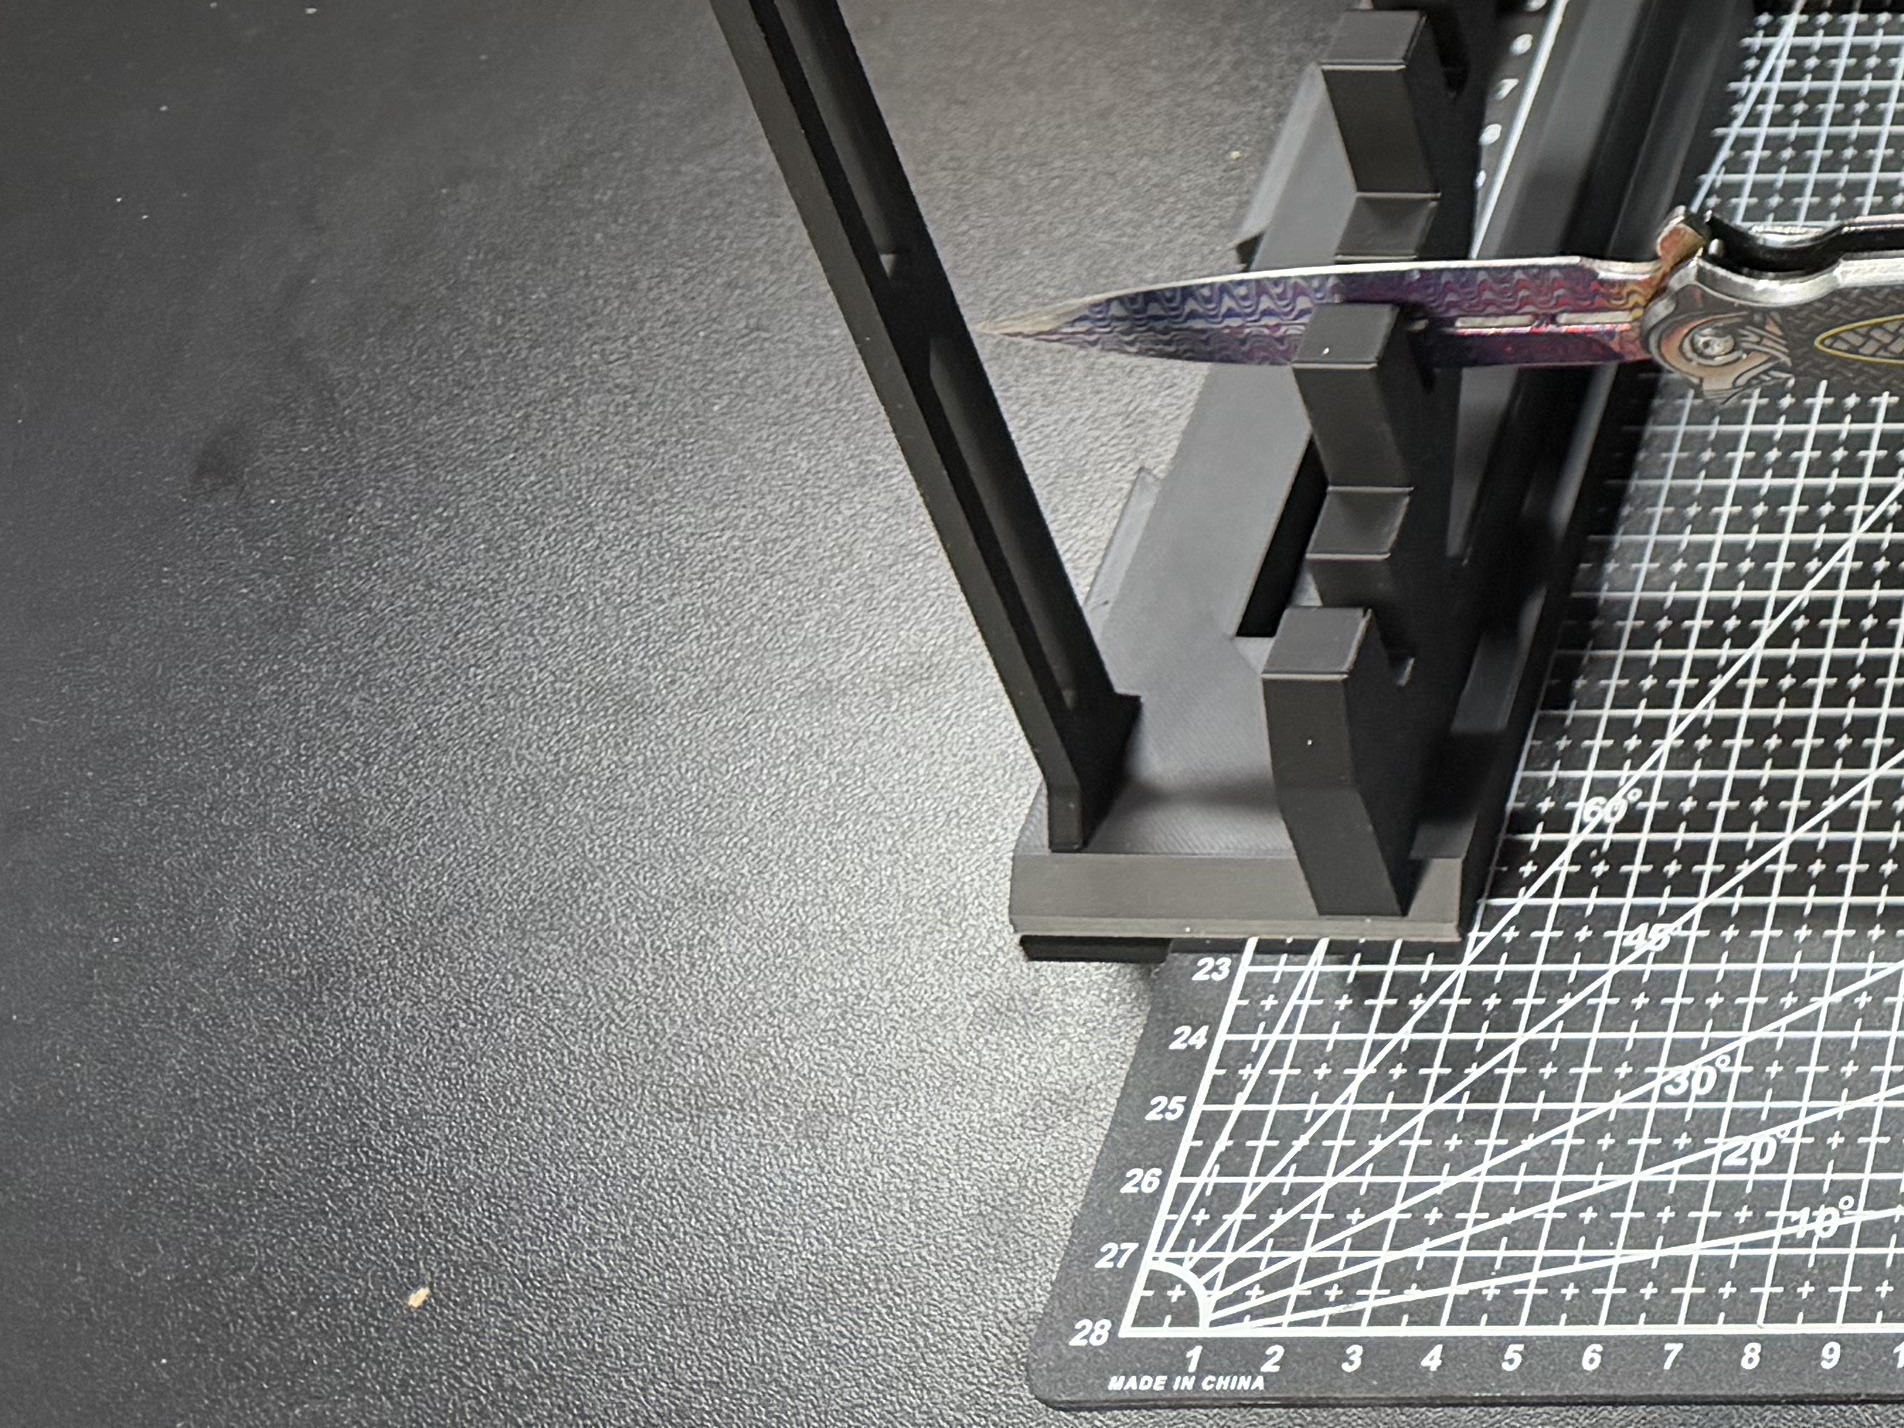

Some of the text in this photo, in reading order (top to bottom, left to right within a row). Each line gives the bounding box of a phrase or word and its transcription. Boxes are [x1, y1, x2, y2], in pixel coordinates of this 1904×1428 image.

[1069, 956, 1233, 1347] 23 24 25 26 27 28
[1185, 1344, 1204, 1374] 1
[1259, 1344, 1286, 1373] 2
[1340, 1343, 1364, 1374] 3
[1419, 1343, 1444, 1373] 4
[1499, 1343, 1525, 1372] 5
[1581, 1343, 1604, 1376] 6
[1662, 1342, 1684, 1375] 7
[1740, 1341, 1762, 1371] 8
[1819, 1340, 1842, 1371] 9
[1107, 1375, 1266, 1392] MADE IN CHINA
